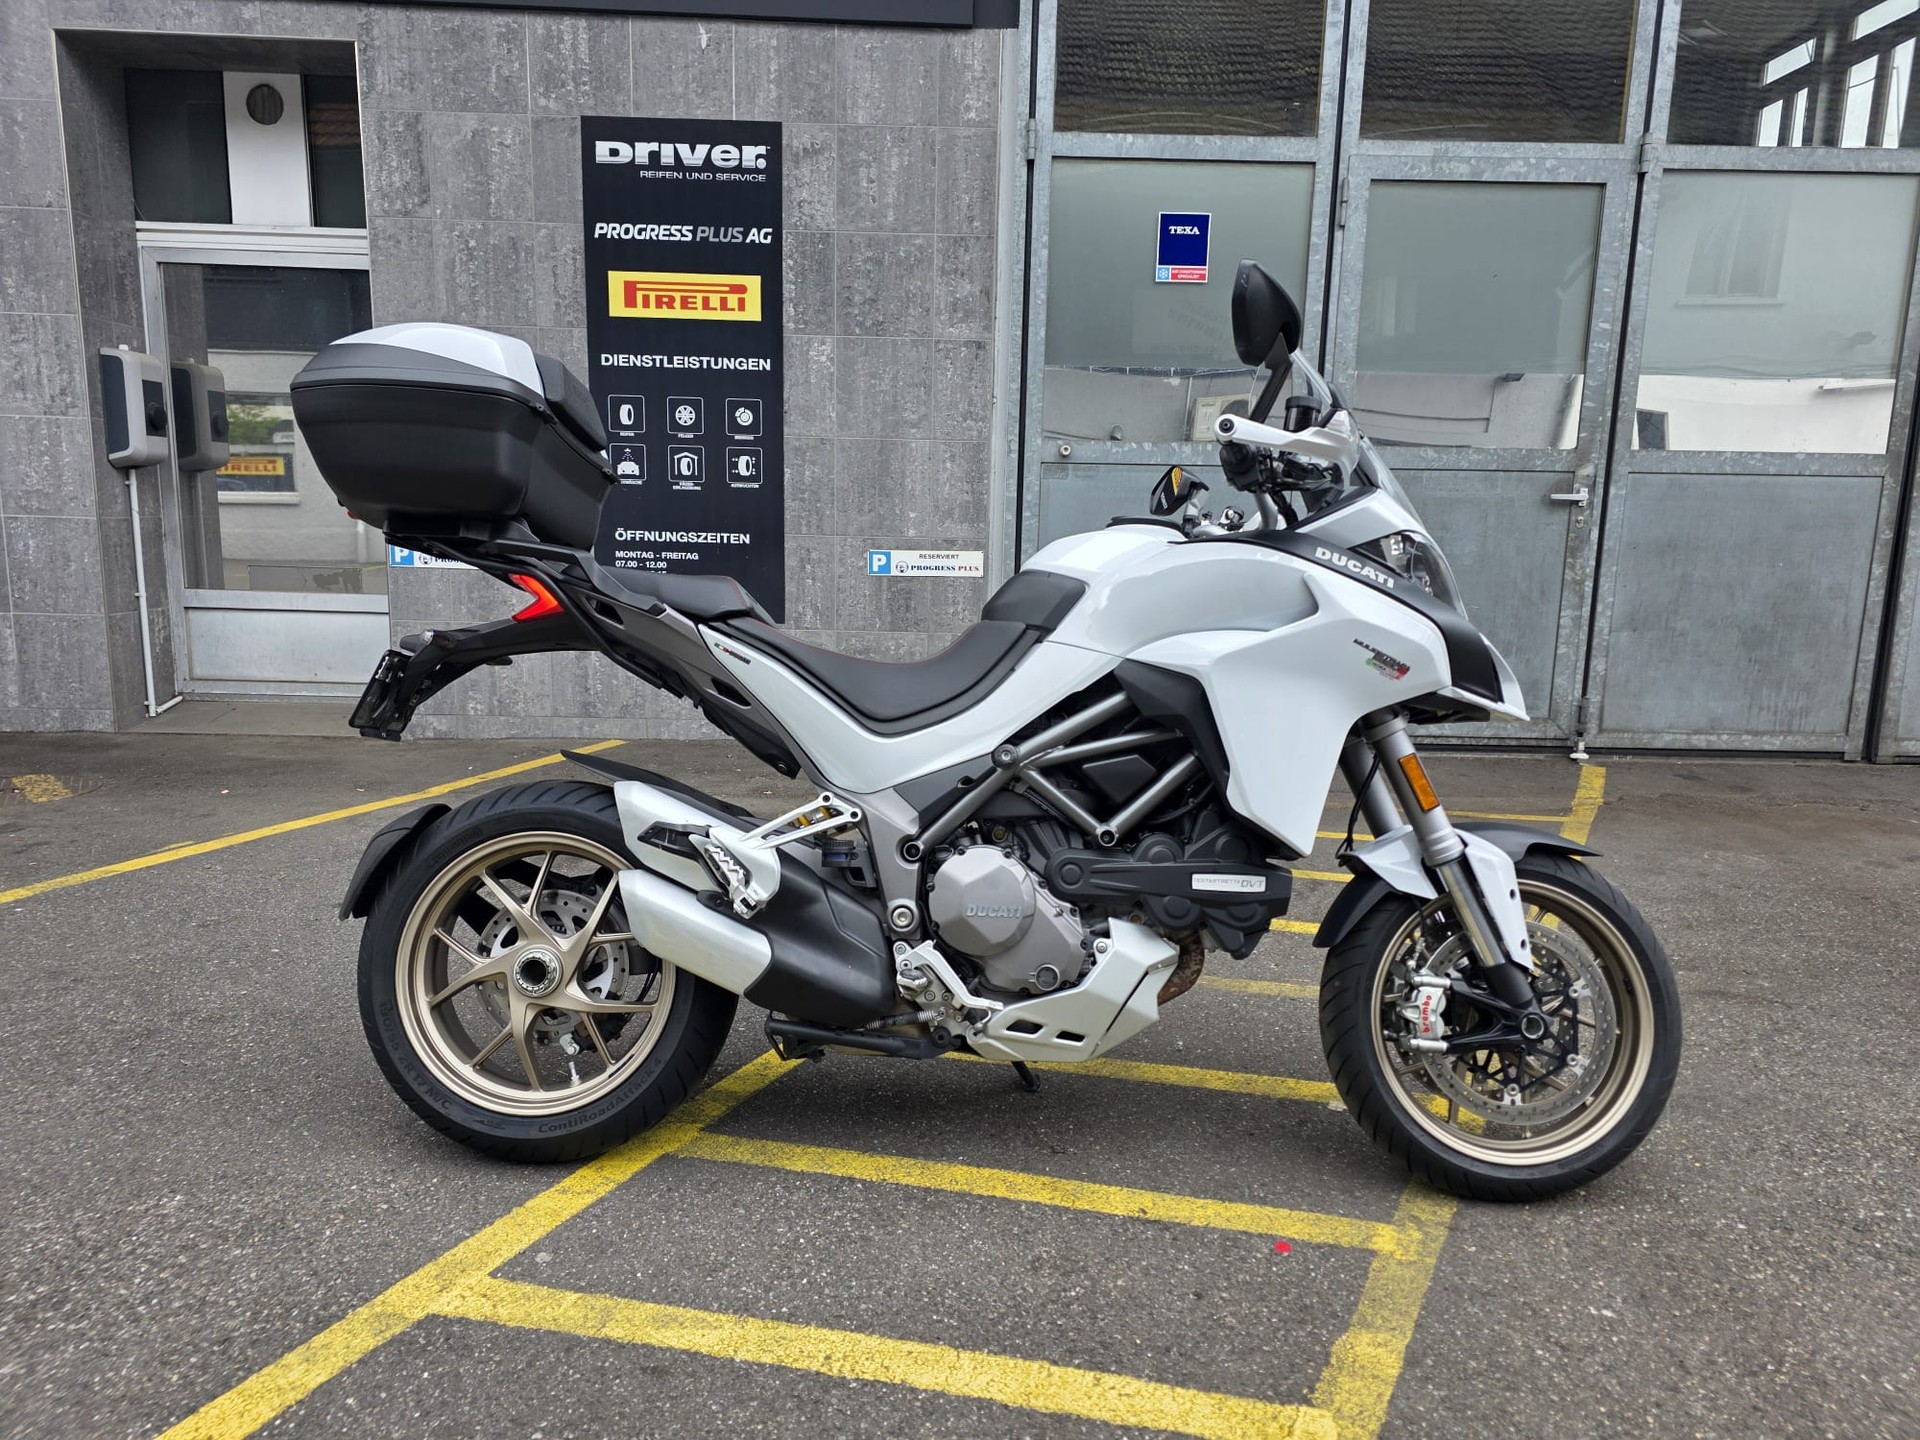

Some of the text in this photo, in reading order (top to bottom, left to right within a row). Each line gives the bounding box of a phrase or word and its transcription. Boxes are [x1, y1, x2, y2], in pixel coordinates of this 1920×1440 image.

[640, 170, 767, 182] REIFEN UND SERVICE
[594, 222, 772, 244] PROGRESS PLUS AG
[1168, 225, 1200, 235] TEXA
[623, 280, 748, 312] PIRELLI
[600, 353, 771, 371] DIENSTLEISTUNGEN
[614, 527, 750, 545] ÖFFNUNGSZEITEN
[615, 550, 654, 559] MONTAG
[661, 552, 699, 561] FREITAG
[615, 560, 637, 568] 07.00
[645, 561, 667, 569] 12.00
[872, 554, 887, 572] P
[910, 564, 956, 572] PROGRESS
[1315, 547, 1395, 589] DUCATI
[966, 905, 1022, 918] DUCATI
[1421, 994, 1433, 1034] brembo
[538, 1067, 655, 1133] ContiRoadAttack
